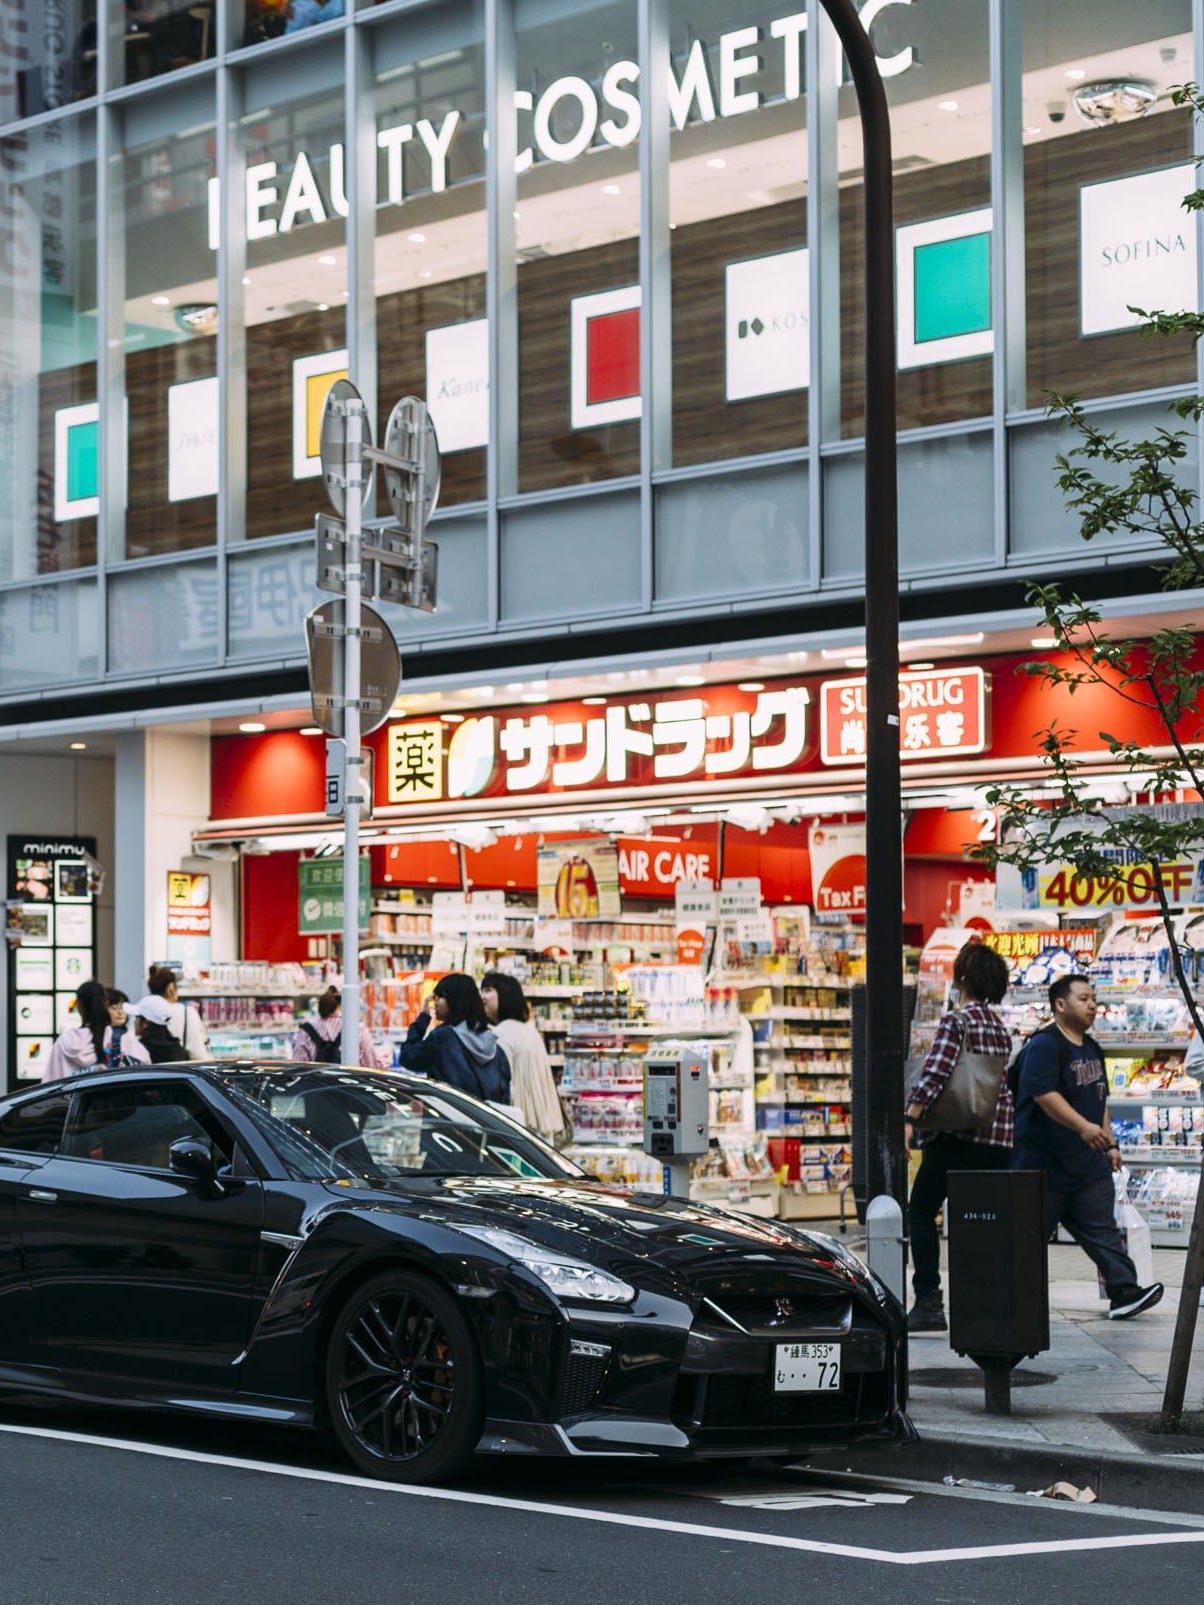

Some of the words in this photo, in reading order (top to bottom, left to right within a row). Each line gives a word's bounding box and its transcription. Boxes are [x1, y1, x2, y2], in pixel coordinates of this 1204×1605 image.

[1101, 233, 1187, 267] SOFINA
[771, 311, 810, 334] KOS
[840, 677, 964, 714] SUDRUG
[500, 687, 811, 791] サンドラッグ
[840, 709, 965, 755] 尚乐客
[395, 729, 435, 793] 薬
[22, 843, 86, 856] minimu
[618, 850, 650, 882] AIR
[653, 850, 711, 884] CARE
[819, 887, 852, 908] Tax
[790, 1345, 810, 1359] 練馬
[811, 1344, 829, 1359] 353
[818, 1361, 839, 1389] 72
